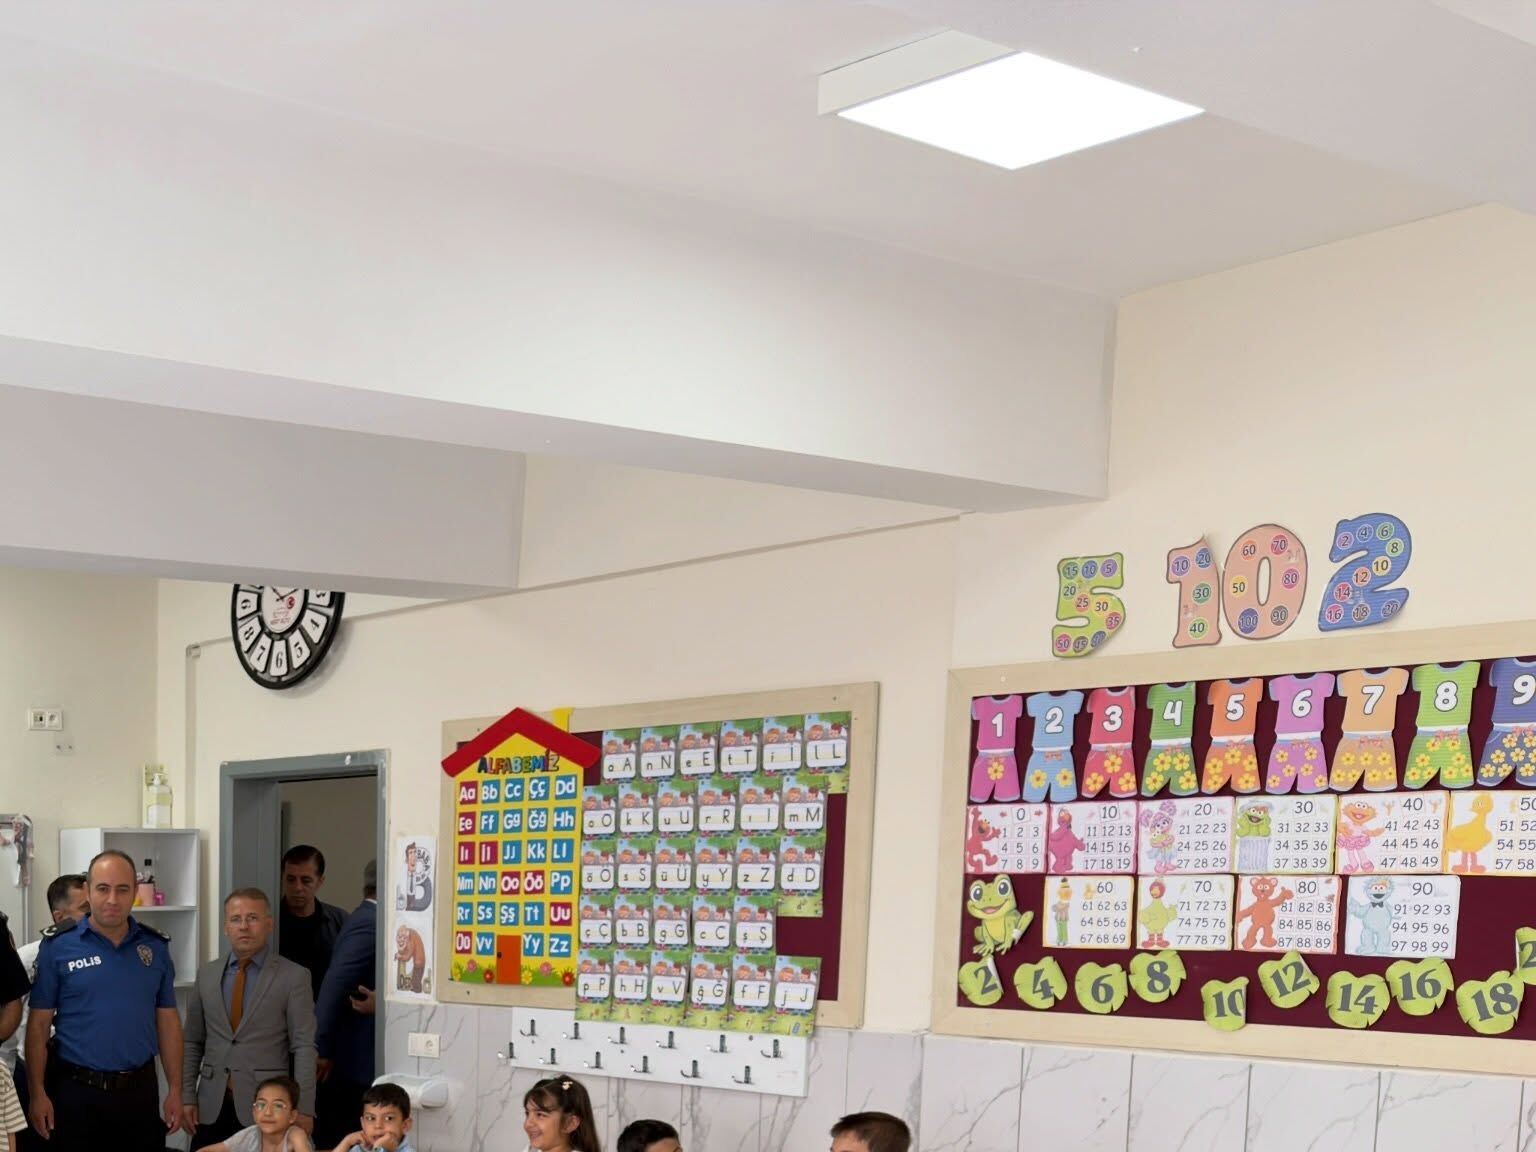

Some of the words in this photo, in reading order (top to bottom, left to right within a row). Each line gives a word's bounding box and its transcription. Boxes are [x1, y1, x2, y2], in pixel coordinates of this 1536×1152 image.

[1318, 512, 1412, 632] 2
[1166, 523, 1308, 649] 10
[1052, 552, 1126, 658] 5
[1433, 680, 1458, 712] 8
[1512, 674, 1536, 705] 9
[1225, 693, 1245, 721] 5
[1291, 689, 1313, 718] 6
[1361, 684, 1385, 715] 7
[1044, 706, 1064, 733] 2
[1102, 704, 1123, 732] 3
[1163, 700, 1183, 726] 4
[992, 712, 1004, 737] 1
[477, 748, 560, 775] ALFABEMİZ
[460, 786, 475, 801] Aa
[482, 783, 498, 800] Bb
[505, 783, 522, 798] Cc
[529, 779, 545, 797] Çç
[556, 777, 575, 795] Dd
[1102, 806, 1117, 818] 10
[1194, 803, 1213, 816] 20
[1294, 801, 1314, 814] 30
[1403, 798, 1423, 811] 40
[459, 817, 473, 831] Ee
[481, 815, 494, 831] Ff
[503, 813, 521, 828] Gg
[554, 812, 574, 828] Hh
[1016, 808, 1025, 821] 0
[1179, 824, 1191, 834] 21
[1195, 824, 1210, 834] 22
[1212, 823, 1227, 833] 23
[1277, 823, 1290, 833] 31
[1295, 823, 1310, 833] 32
[1314, 822, 1329, 832] 33
[1385, 821, 1398, 831] 41
[1403, 820, 1419, 830] 42
[1423, 820, 1440, 830] 43
[528, 842, 545, 859] Kk
[1275, 840, 1290, 850] 34
[1293, 840, 1309, 850] 35
[1313, 840, 1328, 851] 36
[1382, 839, 1397, 848] 44
[1401, 839, 1418, 849] 45
[1422, 838, 1439, 849] 46
[1274, 858, 1289, 868] 37
[1293, 858, 1308, 868] 38
[1312, 858, 1327, 868] 39
[1380, 857, 1396, 867] 47
[1400, 857, 1417, 867] 48
[1421, 857, 1439, 867] 49
[457, 876, 473, 889] Mm
[479, 875, 496, 889] Nn
[502, 876, 519, 891] Oo
[551, 873, 571, 890] Pp
[1097, 882, 1113, 894] 60
[1194, 881, 1212, 893] 70
[1297, 881, 1317, 894] 80
[1412, 883, 1433, 896] 90
[457, 906, 469, 920] Rr
[477, 905, 493, 920] Ss
[500, 905, 515, 924] Şş
[525, 905, 539, 922] Tt
[551, 906, 570, 922] Uu
[1280, 903, 1293, 912] 81
[1298, 903, 1313, 912] 82
[1317, 903, 1332, 913] 83
[1394, 904, 1408, 915] 91
[1413, 904, 1429, 915] 92
[1434, 905, 1451, 915] 93
[1278, 920, 1293, 930] 84
[1297, 920, 1312, 930] 85
[1316, 920, 1331, 931] 86
[1392, 922, 1408, 932] 94
[1412, 922, 1429, 933] 95
[1433, 923, 1450, 935] 96
[476, 936, 492, 950] Vv
[523, 934, 540, 954] Yy
[550, 937, 569, 952] Zz
[1278, 937, 1293, 948] 87
[1296, 937, 1312, 948] 88
[1315, 938, 1331, 948] 89
[1391, 941, 1407, 951] 97
[1411, 941, 1428, 952] 98
[1432, 942, 1449, 953] 99
[974, 965, 998, 995] 2
[1032, 968, 1054, 1000] 4
[1146, 960, 1171, 993] 8
[1270, 961, 1312, 997] 12
[1399, 968, 1442, 1001] 16
[1091, 974, 1114, 1004] 6
[1337, 983, 1378, 1015] 14
[1471, 982, 1518, 1022] 18
